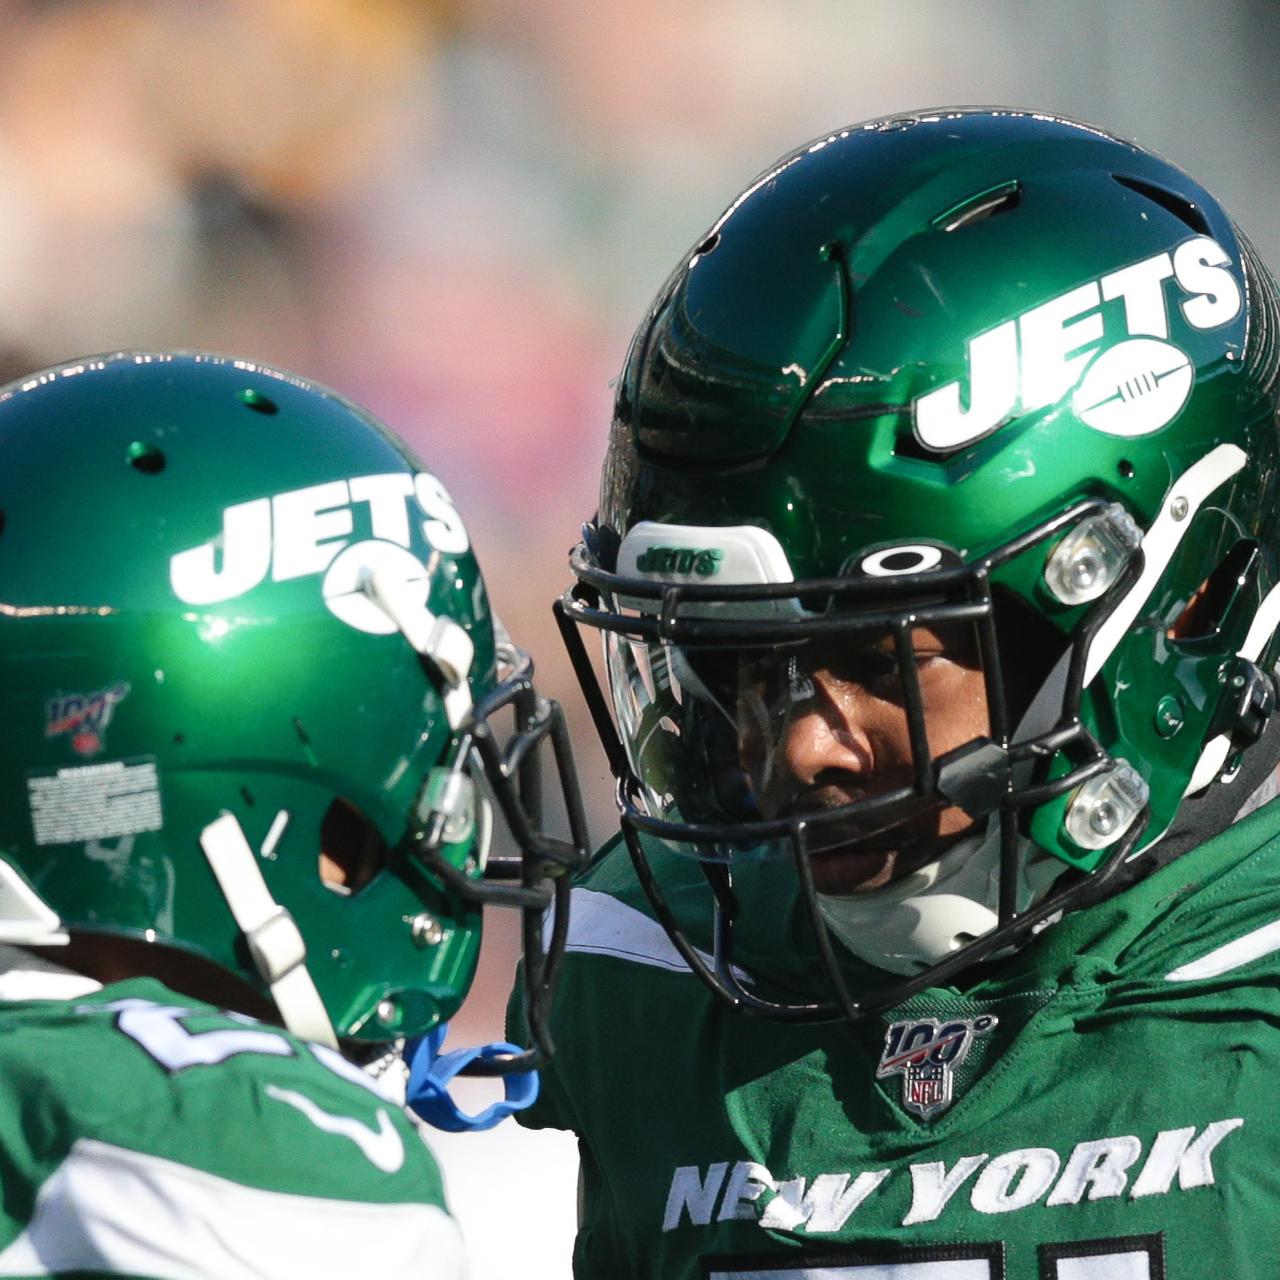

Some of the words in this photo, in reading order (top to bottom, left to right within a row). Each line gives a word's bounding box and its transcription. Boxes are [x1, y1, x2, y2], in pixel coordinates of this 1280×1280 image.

[911, 233, 1244, 451] JETS
[169, 471, 470, 606] JETS
[911, 1080, 944, 1104] NFL
[661, 1160, 891, 1233] NEW
[901, 1117, 1245, 1227] YORK
